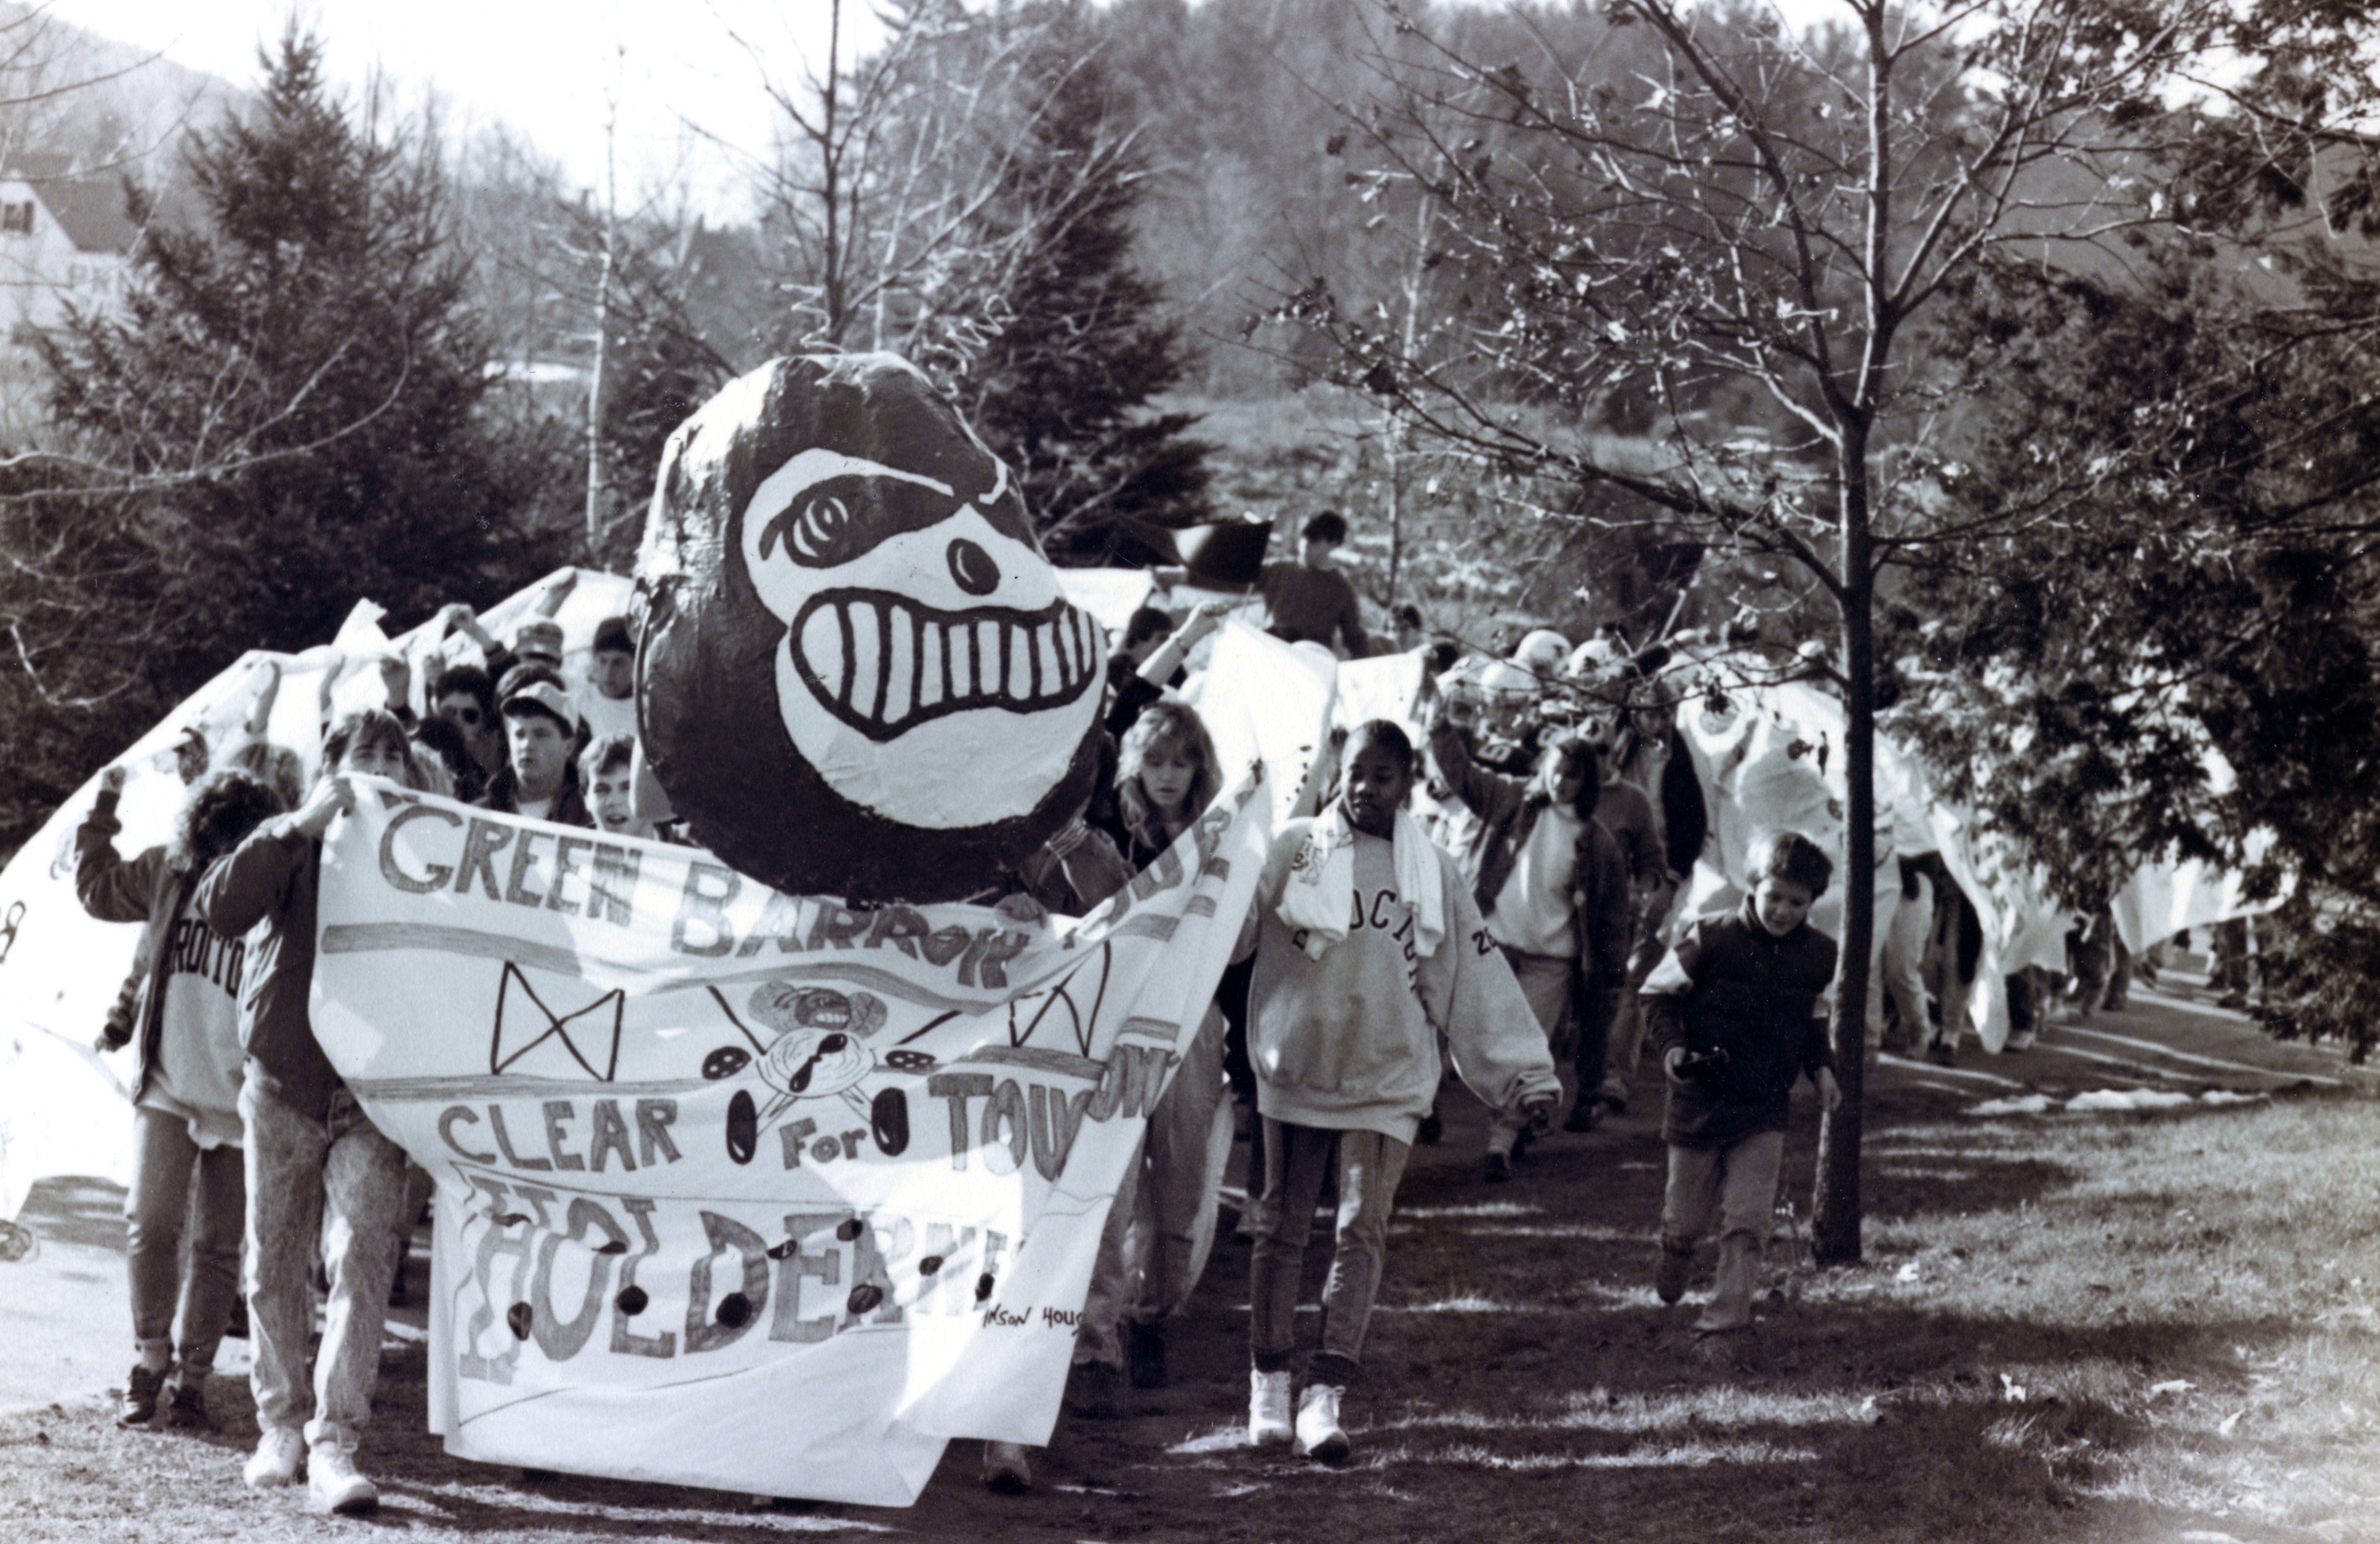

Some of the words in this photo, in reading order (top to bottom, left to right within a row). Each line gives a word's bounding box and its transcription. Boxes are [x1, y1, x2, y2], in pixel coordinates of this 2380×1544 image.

[379, 805, 642, 927] GREEN
[438, 1099, 682, 1173] CLEAR
[779, 1118, 866, 1169] For
[1043, 1307, 1082, 1336] HOUS
